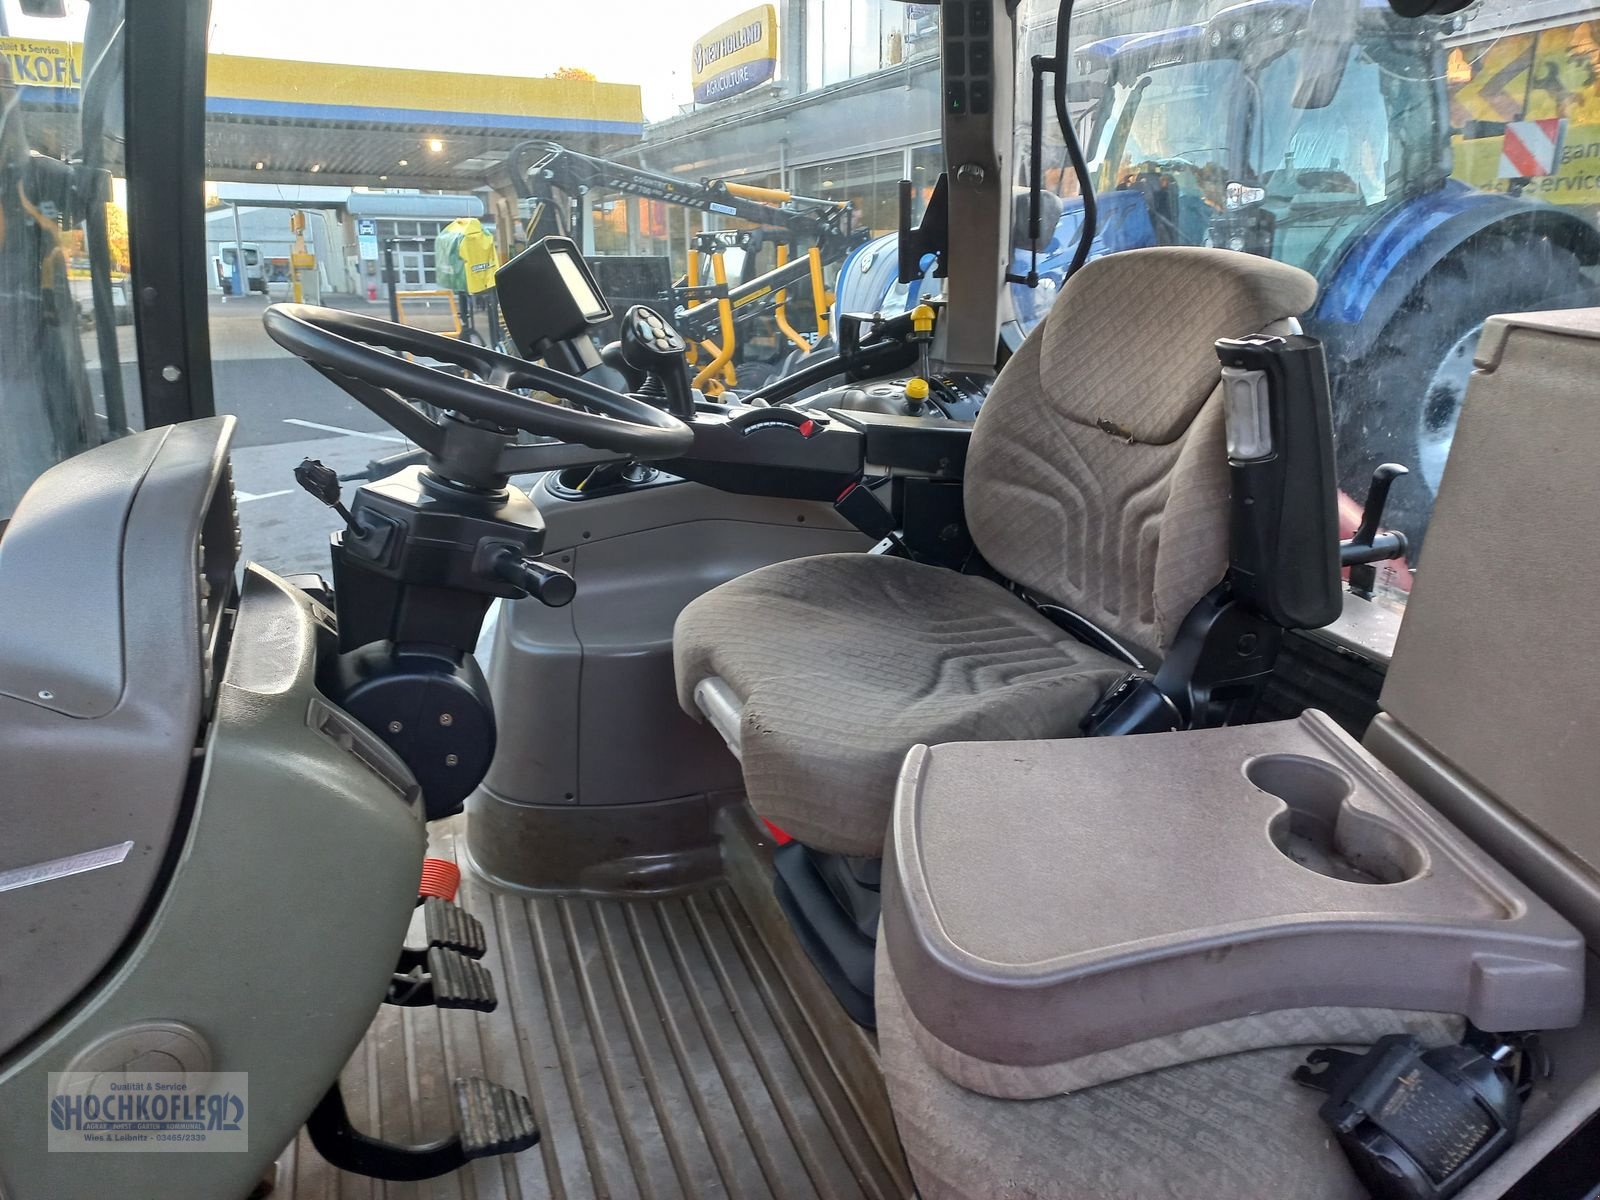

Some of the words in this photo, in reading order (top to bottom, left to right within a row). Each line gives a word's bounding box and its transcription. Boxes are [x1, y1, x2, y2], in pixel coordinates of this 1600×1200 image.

[704, 40, 721, 66] NEW
[722, 20, 762, 57] HOLLAND
[6, 53, 81, 83] KOFL
[706, 66, 749, 97] AGRICULTURE
